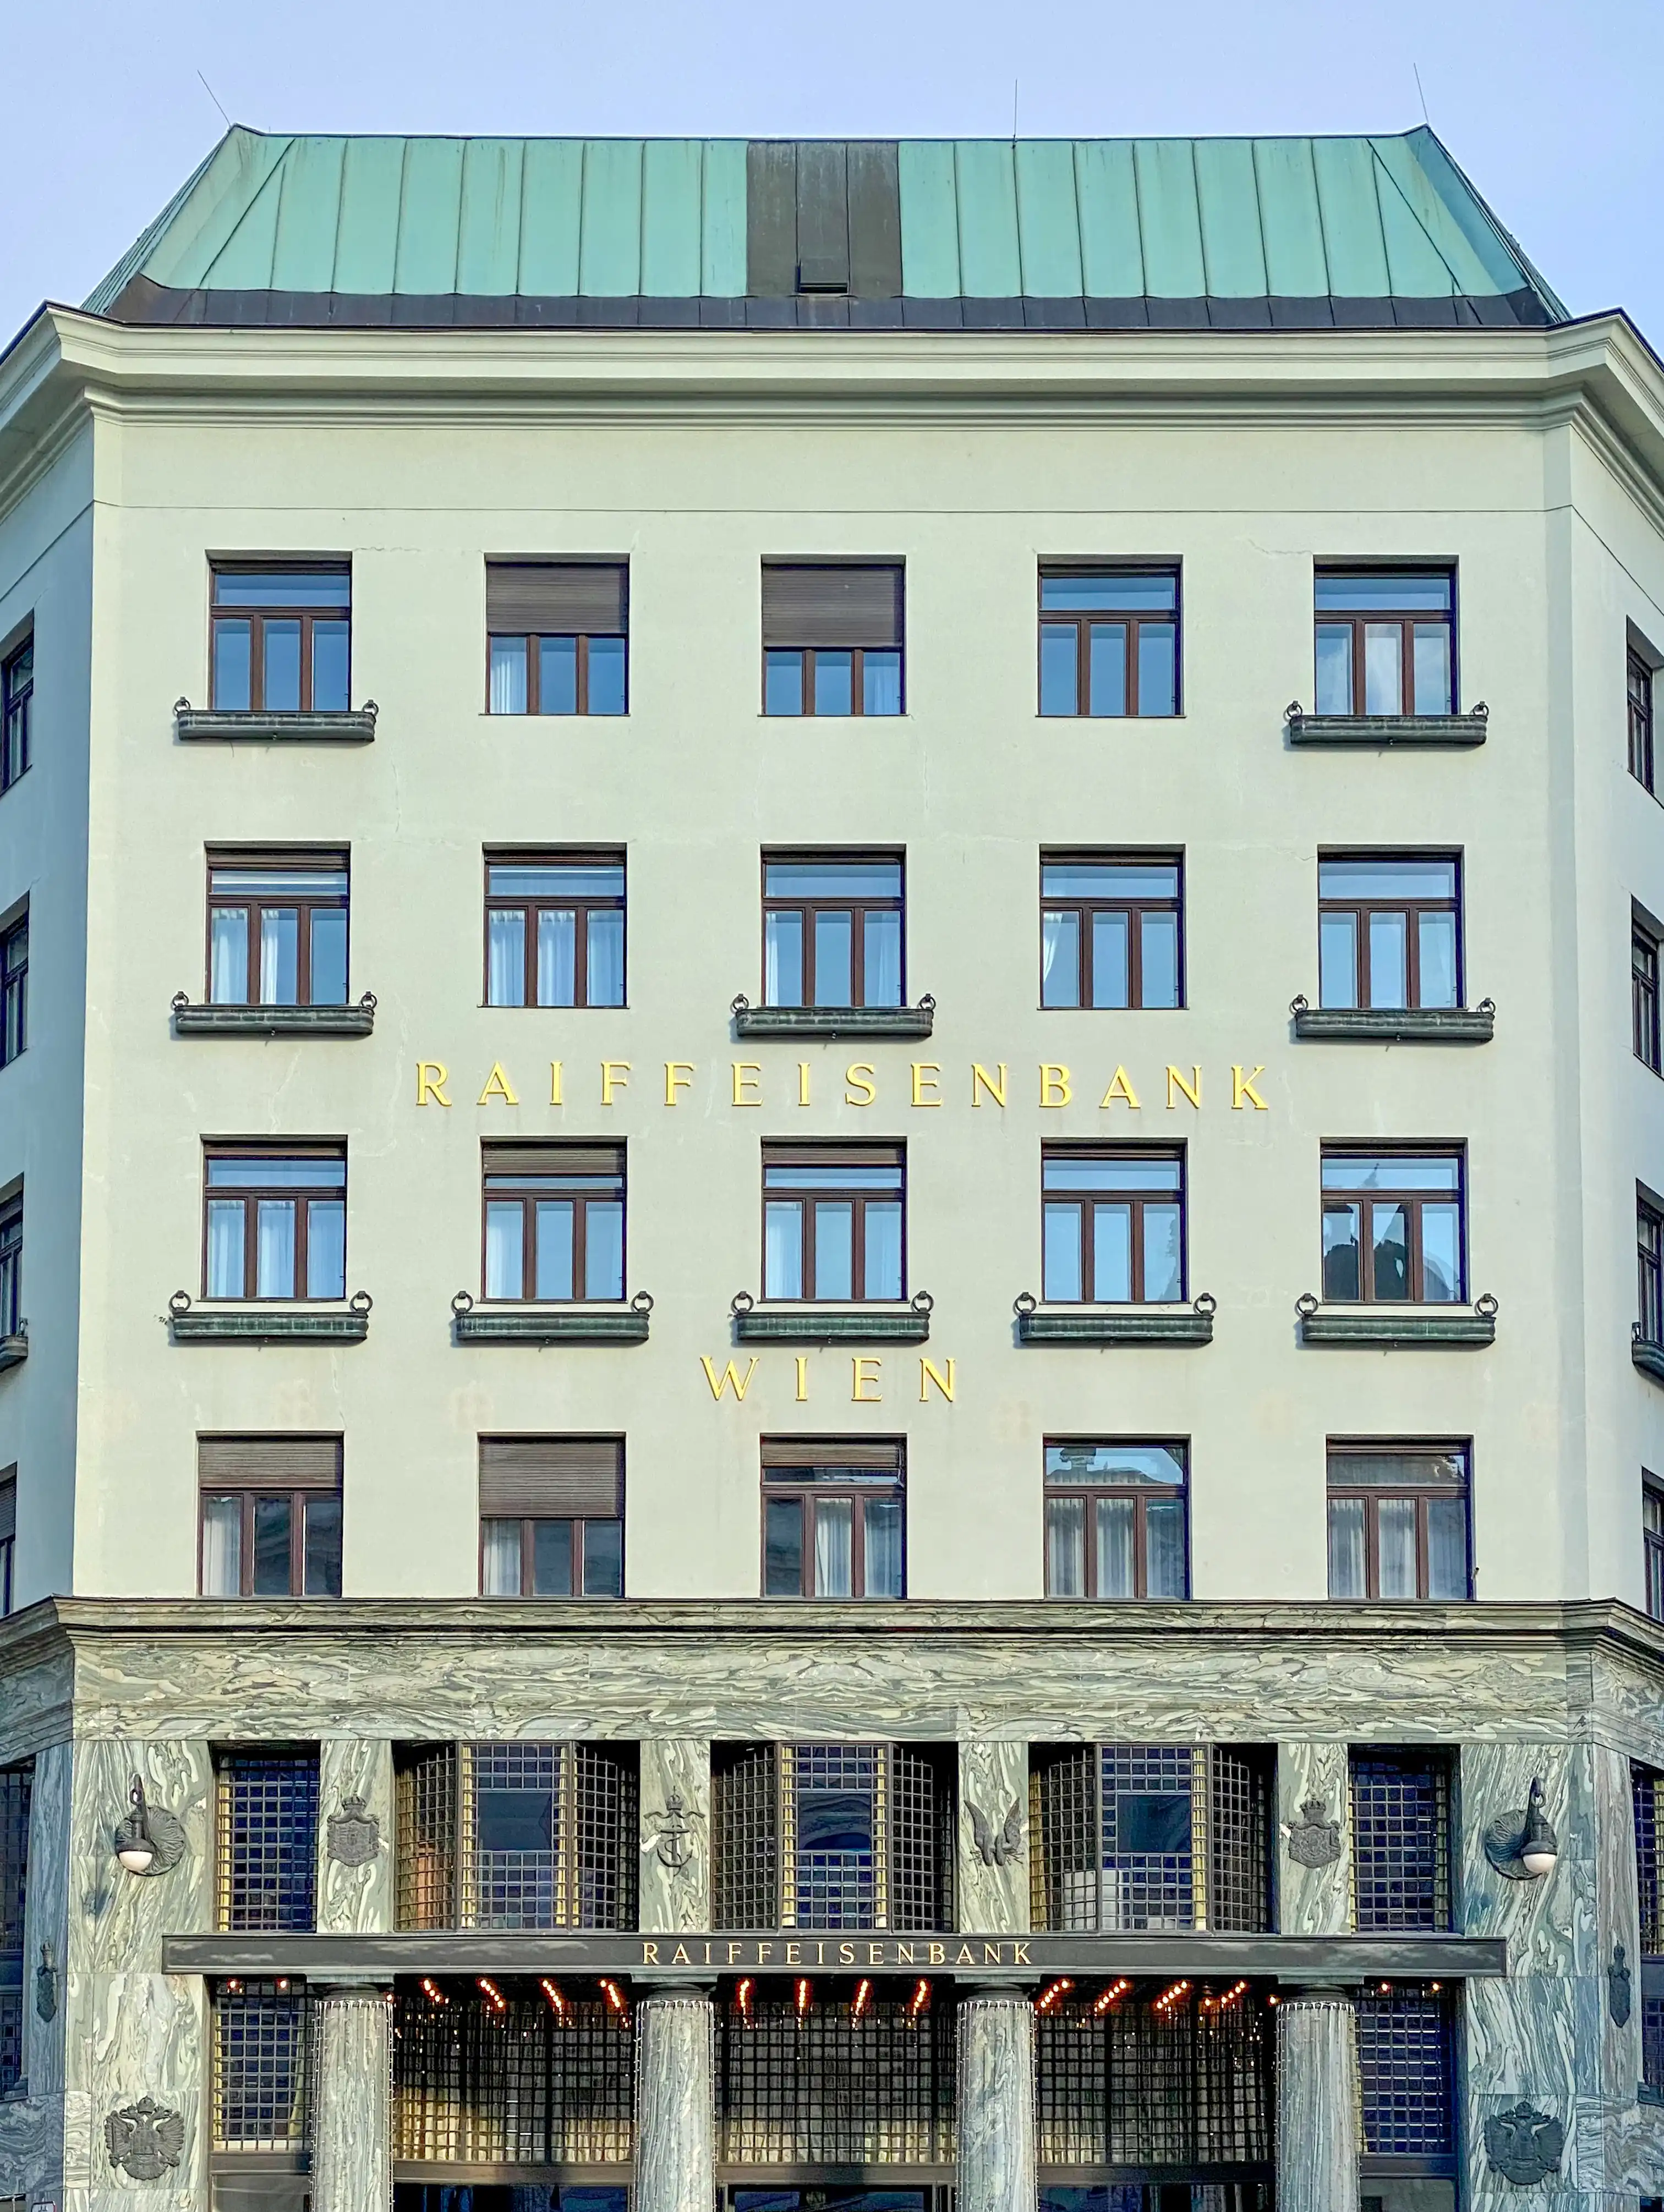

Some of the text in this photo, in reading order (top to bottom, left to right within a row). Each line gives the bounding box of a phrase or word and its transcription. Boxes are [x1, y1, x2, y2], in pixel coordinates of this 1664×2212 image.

[415, 1062, 1269, 1110] RAIFFEISENBANK
[700, 1357, 956, 1402] WIEN
[642, 1942, 1032, 1965] RAIFFEISENBANK
